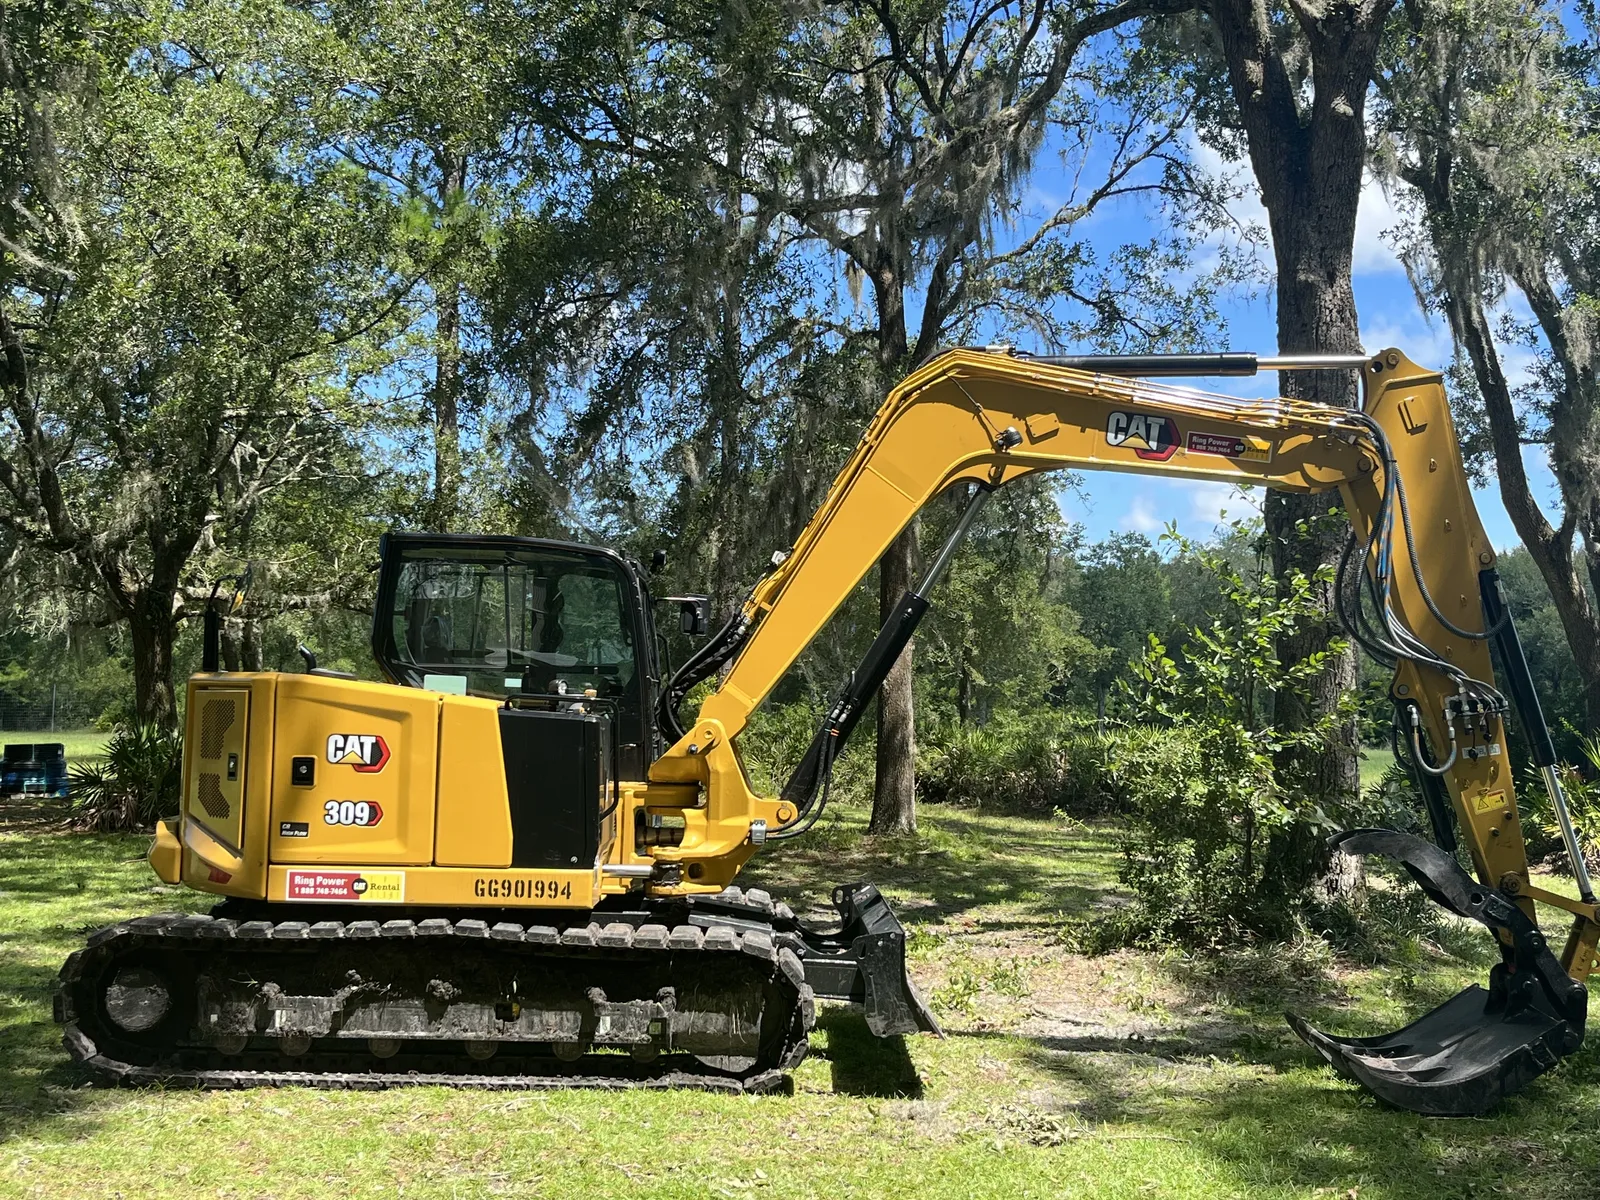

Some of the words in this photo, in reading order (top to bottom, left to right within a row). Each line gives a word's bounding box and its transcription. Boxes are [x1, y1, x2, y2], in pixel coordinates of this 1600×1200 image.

[1107, 412, 1165, 451] CAT
[1192, 436, 1206, 445] Ring
[1208, 438, 1230, 447] Power
[327, 734, 377, 765] CAT
[325, 801, 370, 825] 309
[294, 875, 315, 887] Ring
[316, 876, 346, 886] Power
[353, 882, 367, 891] CAT
[370, 882, 400, 891] Rental
